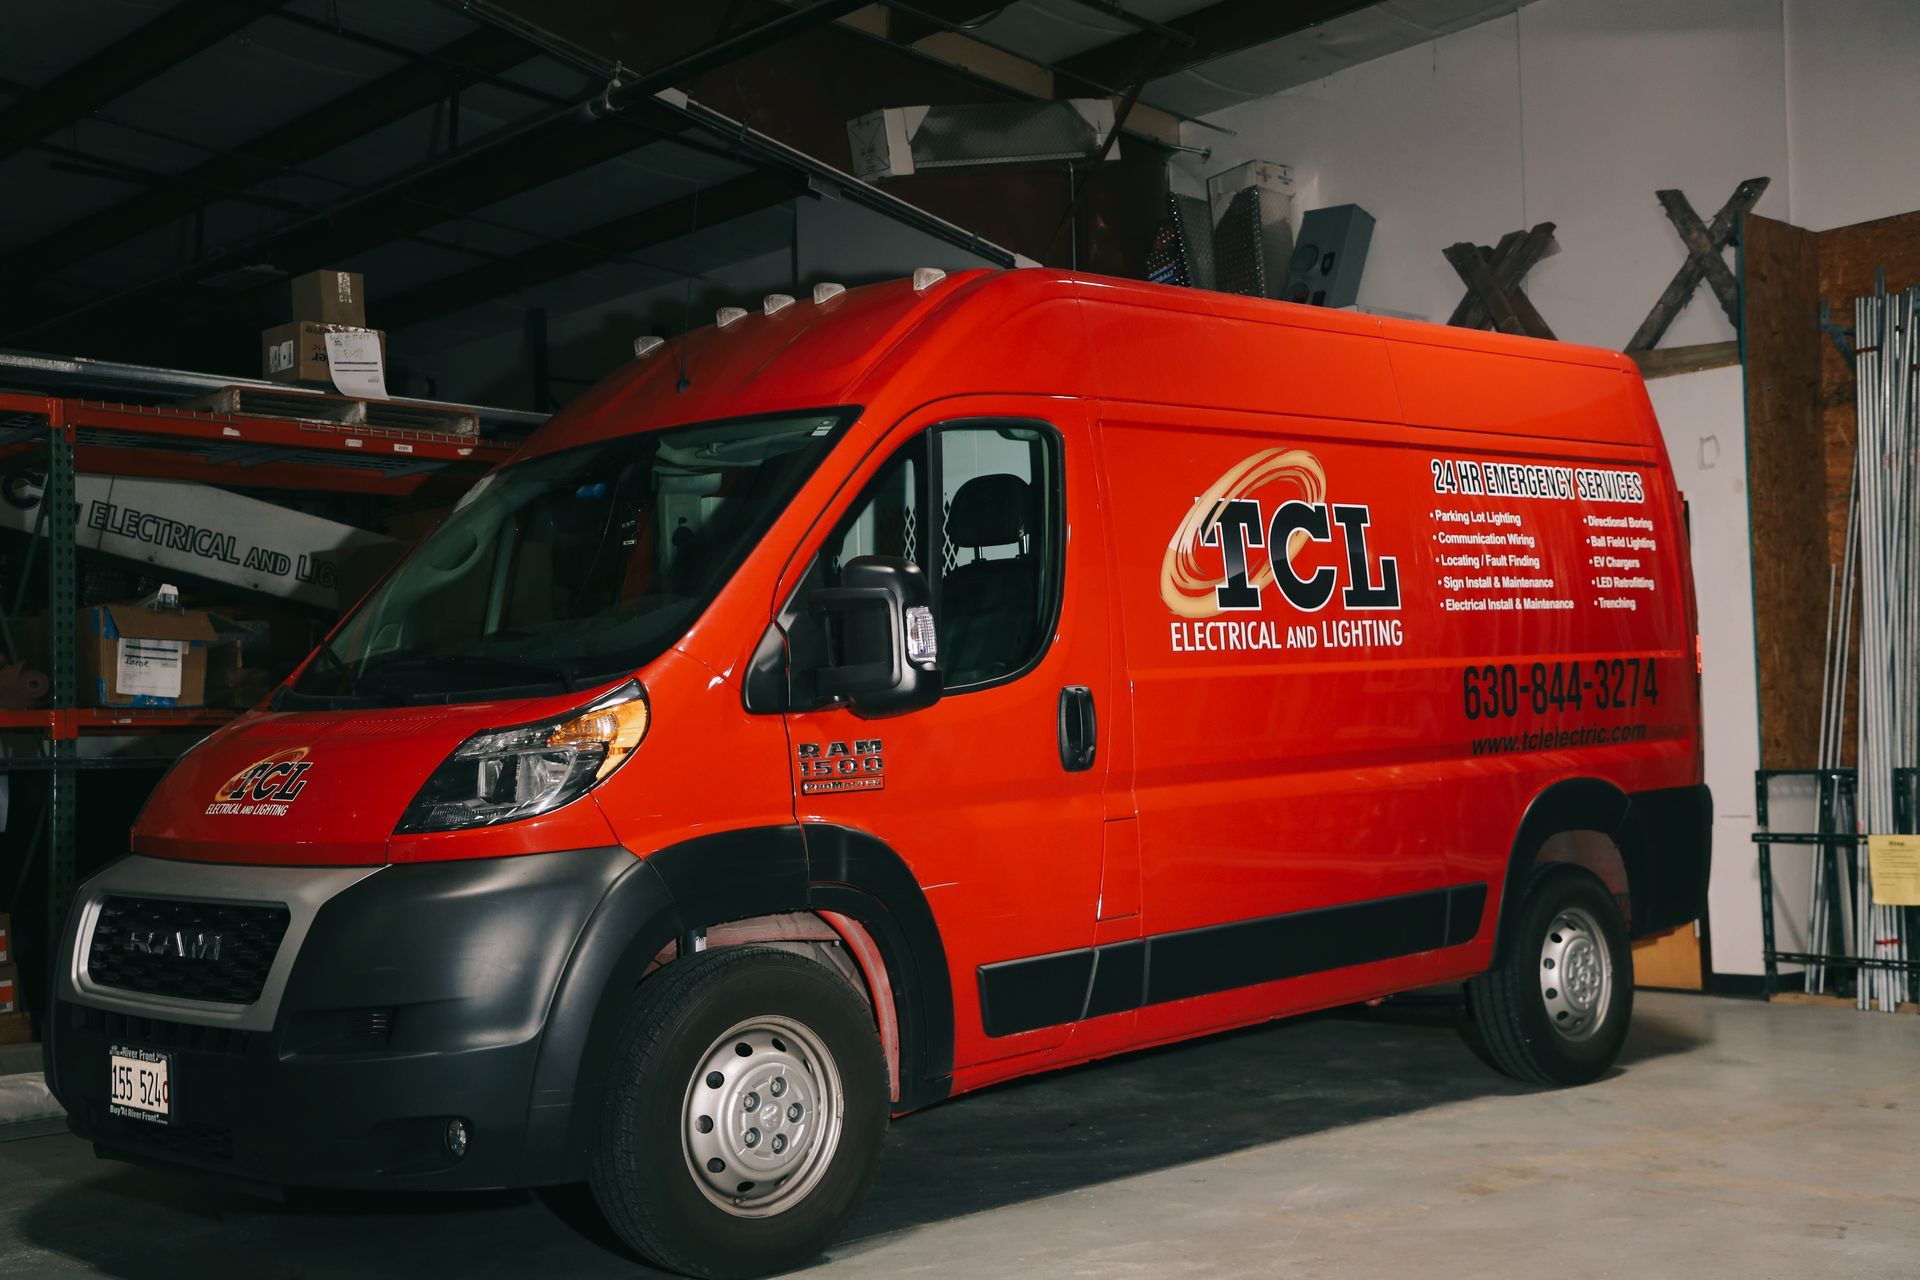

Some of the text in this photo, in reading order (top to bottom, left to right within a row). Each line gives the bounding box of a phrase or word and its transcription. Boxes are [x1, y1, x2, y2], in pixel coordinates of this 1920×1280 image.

[1431, 459, 1644, 503] 24 HR EMERGENCY SERVICES
[1435, 509, 1522, 527] Parking Lot Lighting
[1588, 515, 1654, 531] Directional Boring
[88, 500, 338, 589] ELECTRICAL AND LIG
[1438, 532, 1535, 548] Communication Wiring
[1591, 536, 1656, 551] Ball Field Lighting
[1194, 496, 1401, 612] TCL
[1441, 554, 1480, 569] Locating
[1486, 555, 1508, 567] Fault
[1508, 555, 1540, 569] Finding
[1593, 556, 1640, 570] EV Chargers
[1443, 576, 1554, 591] Sign Install & Maintenance
[1596, 577, 1655, 591] LED Retrofitting
[1445, 598, 1574, 611] Electrical Install & Maintenance
[1598, 597, 1637, 611] Trenching
[1170, 620, 1403, 652] ELECTRICAL AND LIGHTING
[1463, 657, 1658, 720] 630-844-3274
[1472, 723, 1647, 755] www.tclelectric.com
[798, 739, 882, 759] RAM
[799, 756, 883, 777] 1500
[227, 761, 314, 802] TCL
[205, 803, 290, 816] ELECTRICAL AND LIGHTING
[112, 1065, 133, 1101] 155
